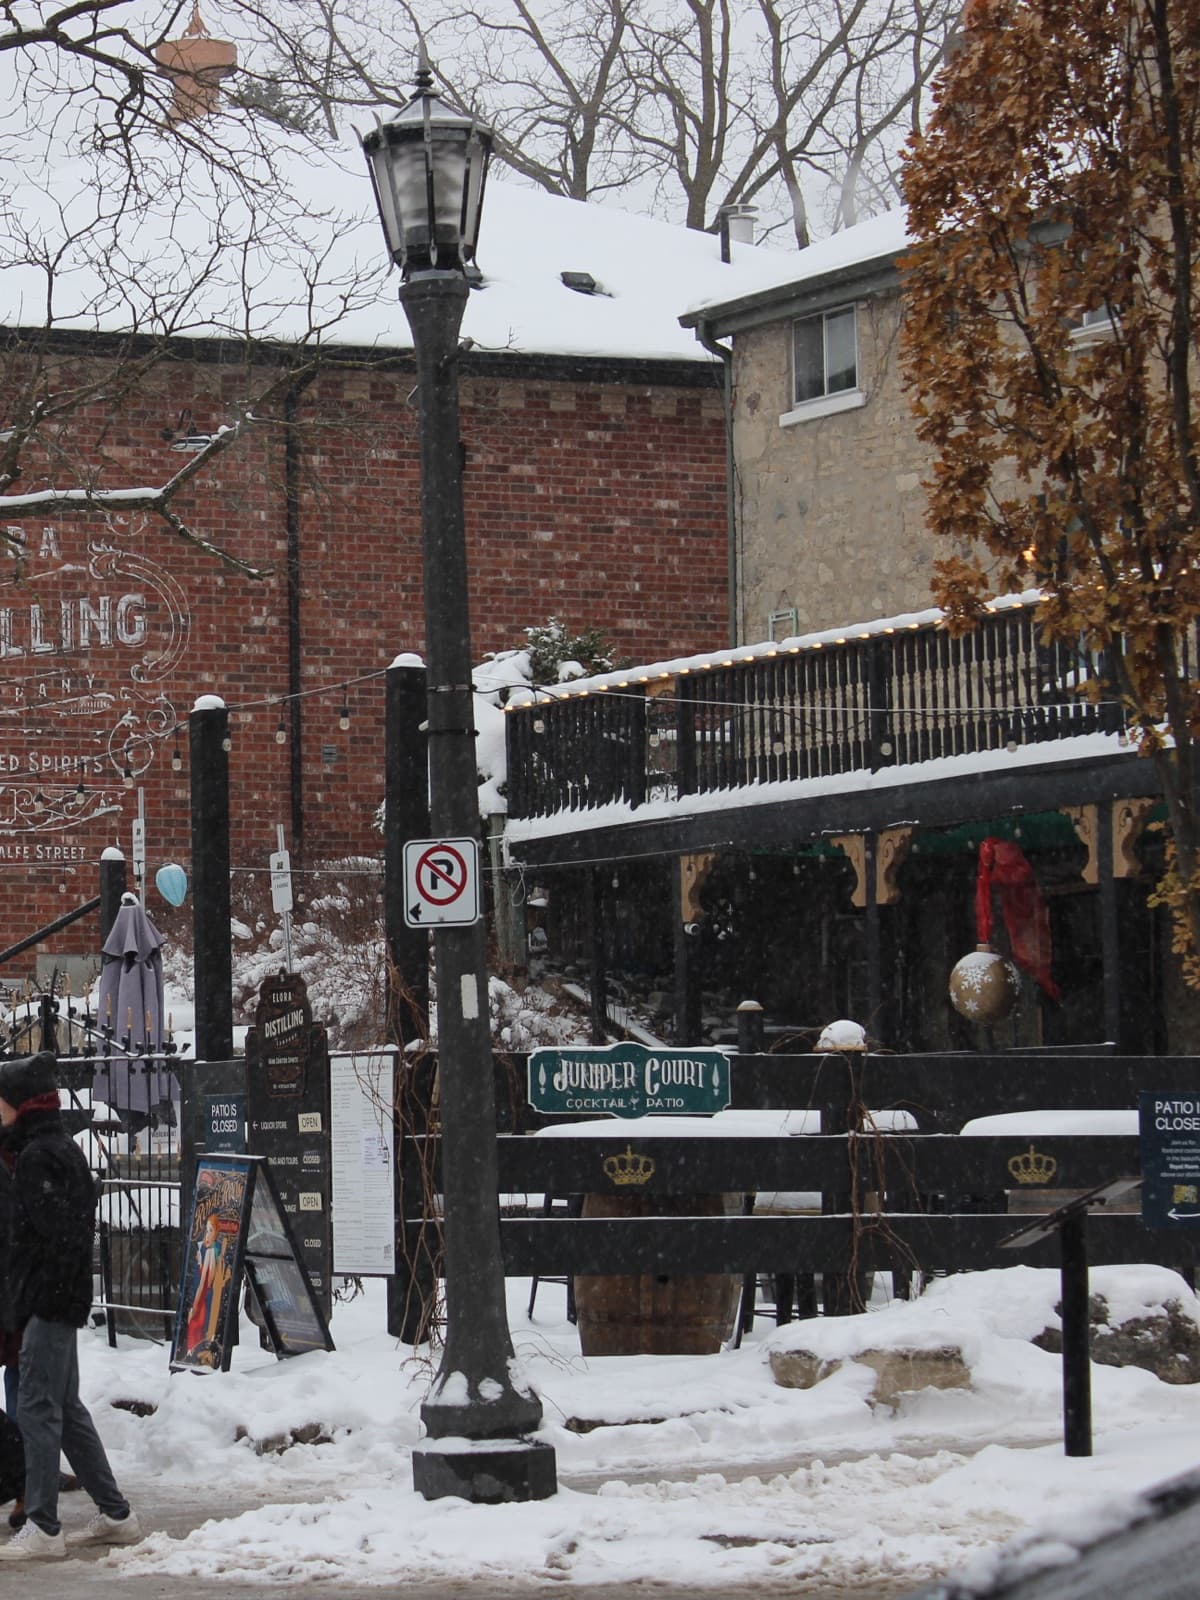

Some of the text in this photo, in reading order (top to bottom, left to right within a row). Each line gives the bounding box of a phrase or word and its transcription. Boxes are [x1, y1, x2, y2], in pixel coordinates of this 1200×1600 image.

[28, 752, 103, 775] SPIRITS
[36, 845, 86, 860] STREET
[272, 992, 292, 1003] ELORA
[265, 1009, 304, 1038] DISTILLING
[553, 1058, 708, 1095] JUNIPER COURT
[566, 1097, 685, 1109] COCKTAIL PATIO
[1155, 1101, 1200, 1114] PATIO I
[211, 1104, 237, 1117] PATIO IS
[211, 1120, 238, 1133] CLOSED
[301, 1116, 318, 1128] OPEN
[1155, 1117, 1200, 1130] CLOSE
[302, 1155, 320, 1164] CLOSED
[302, 1196, 319, 1207] OPEN
[304, 1239, 322, 1248] CLOSED
